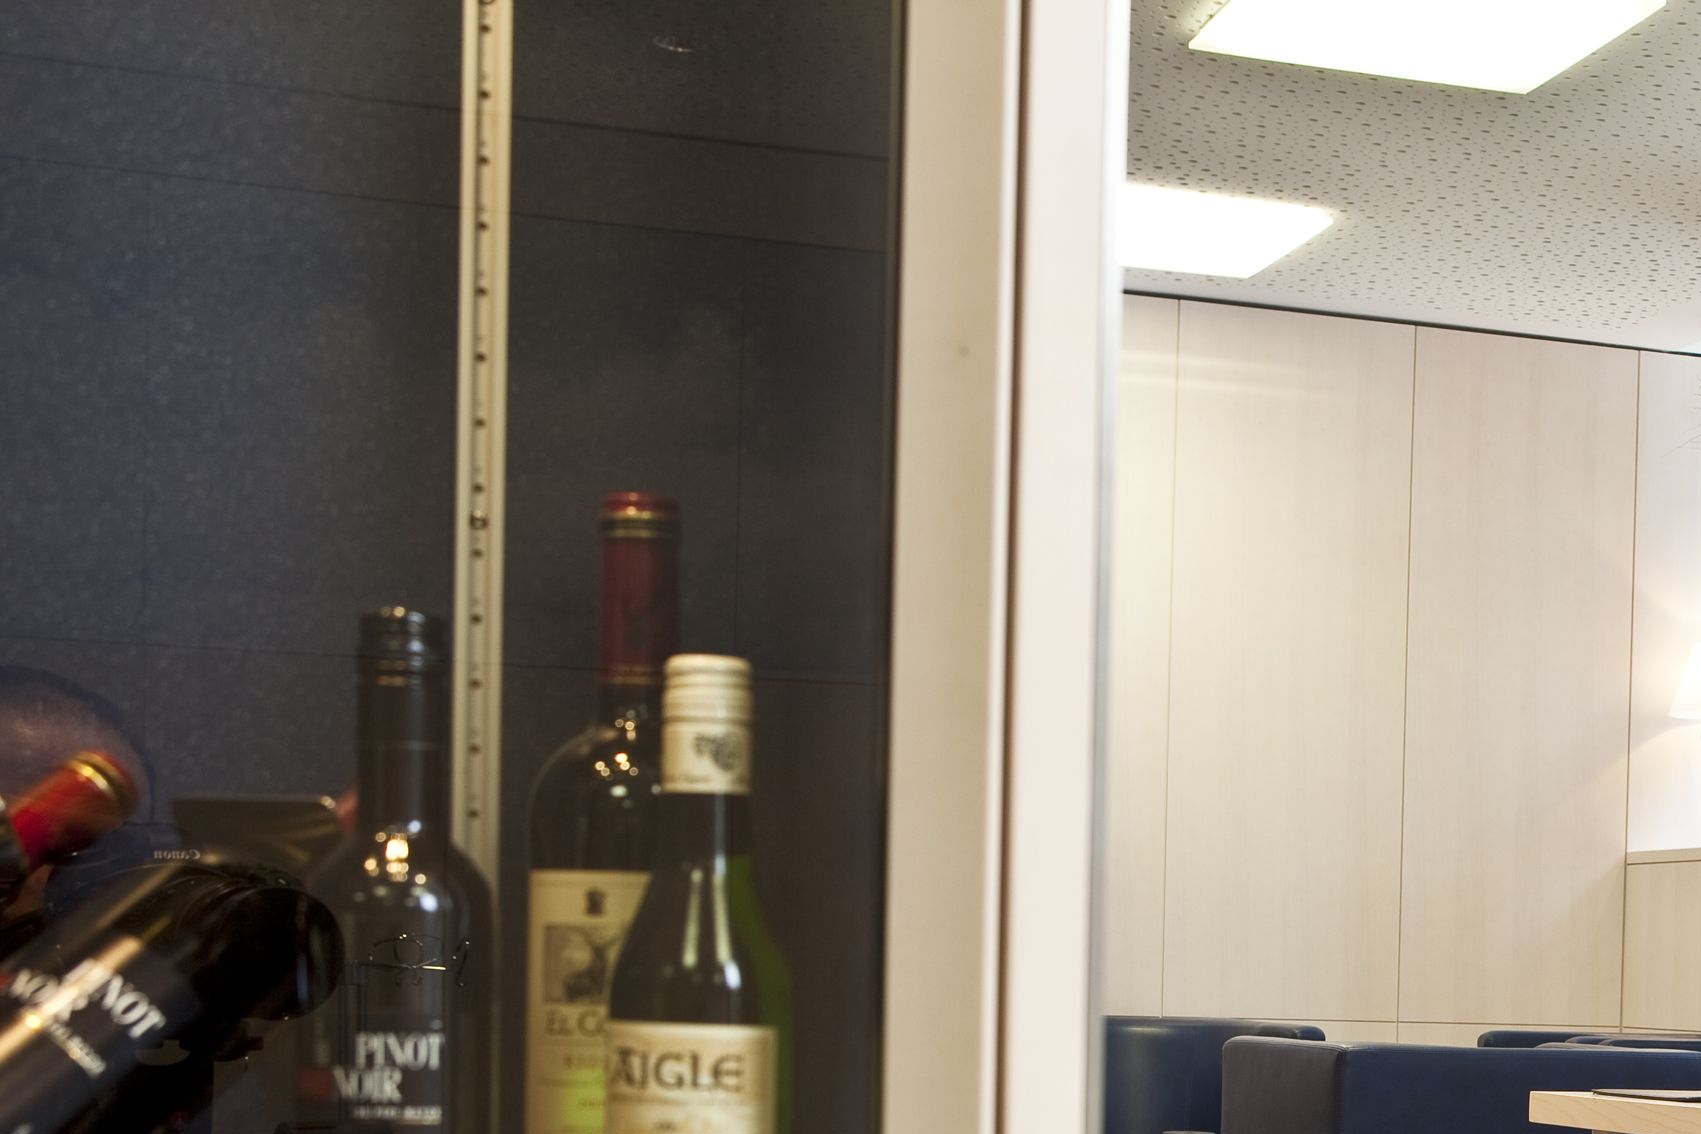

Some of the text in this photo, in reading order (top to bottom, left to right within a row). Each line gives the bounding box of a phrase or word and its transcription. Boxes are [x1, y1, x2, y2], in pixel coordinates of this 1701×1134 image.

[355, 1031, 445, 1070] PINOT
[605, 1045, 746, 1095] AIGLE
[333, 1064, 403, 1103] NOIR
